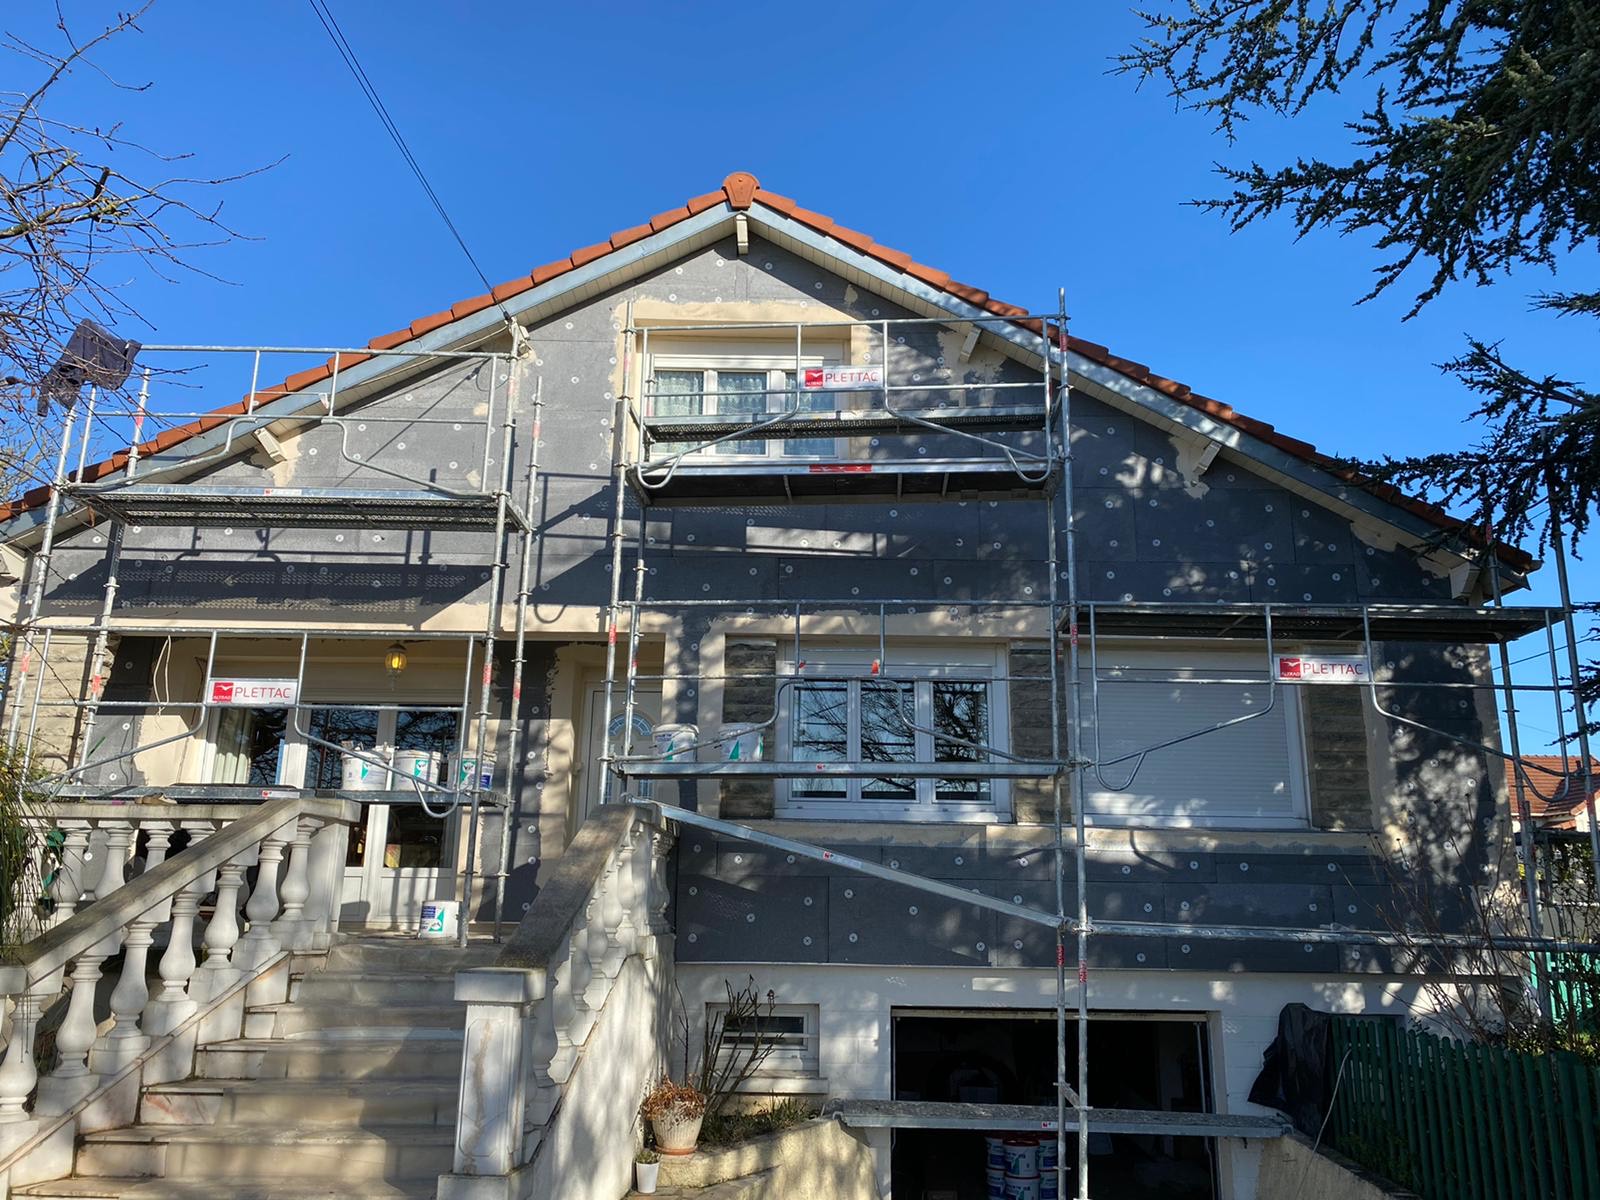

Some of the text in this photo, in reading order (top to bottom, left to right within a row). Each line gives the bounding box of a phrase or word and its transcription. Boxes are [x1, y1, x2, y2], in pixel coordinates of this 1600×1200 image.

[825, 372, 878, 383] PLETTAC
[1303, 663, 1363, 675] PLETTAC
[234, 687, 291, 699] PLETTAC
